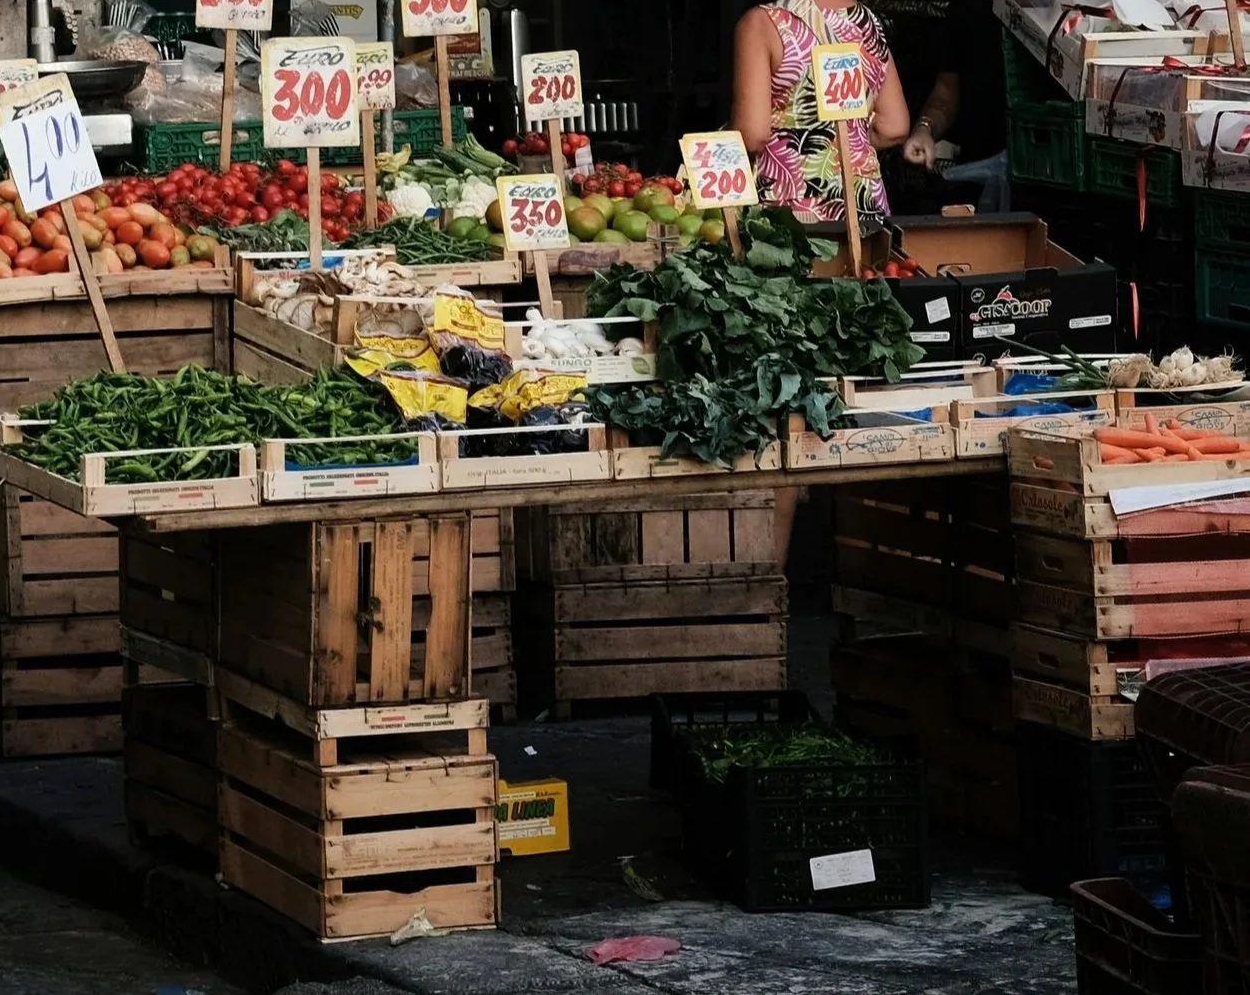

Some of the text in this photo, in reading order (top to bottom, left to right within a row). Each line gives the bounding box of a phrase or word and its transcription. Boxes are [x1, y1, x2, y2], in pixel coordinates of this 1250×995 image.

[279, 46, 345, 67] EURO
[824, 54, 859, 70] EURO
[509, 185, 557, 198] EURO
[511, 797, 556, 821] LINEA
